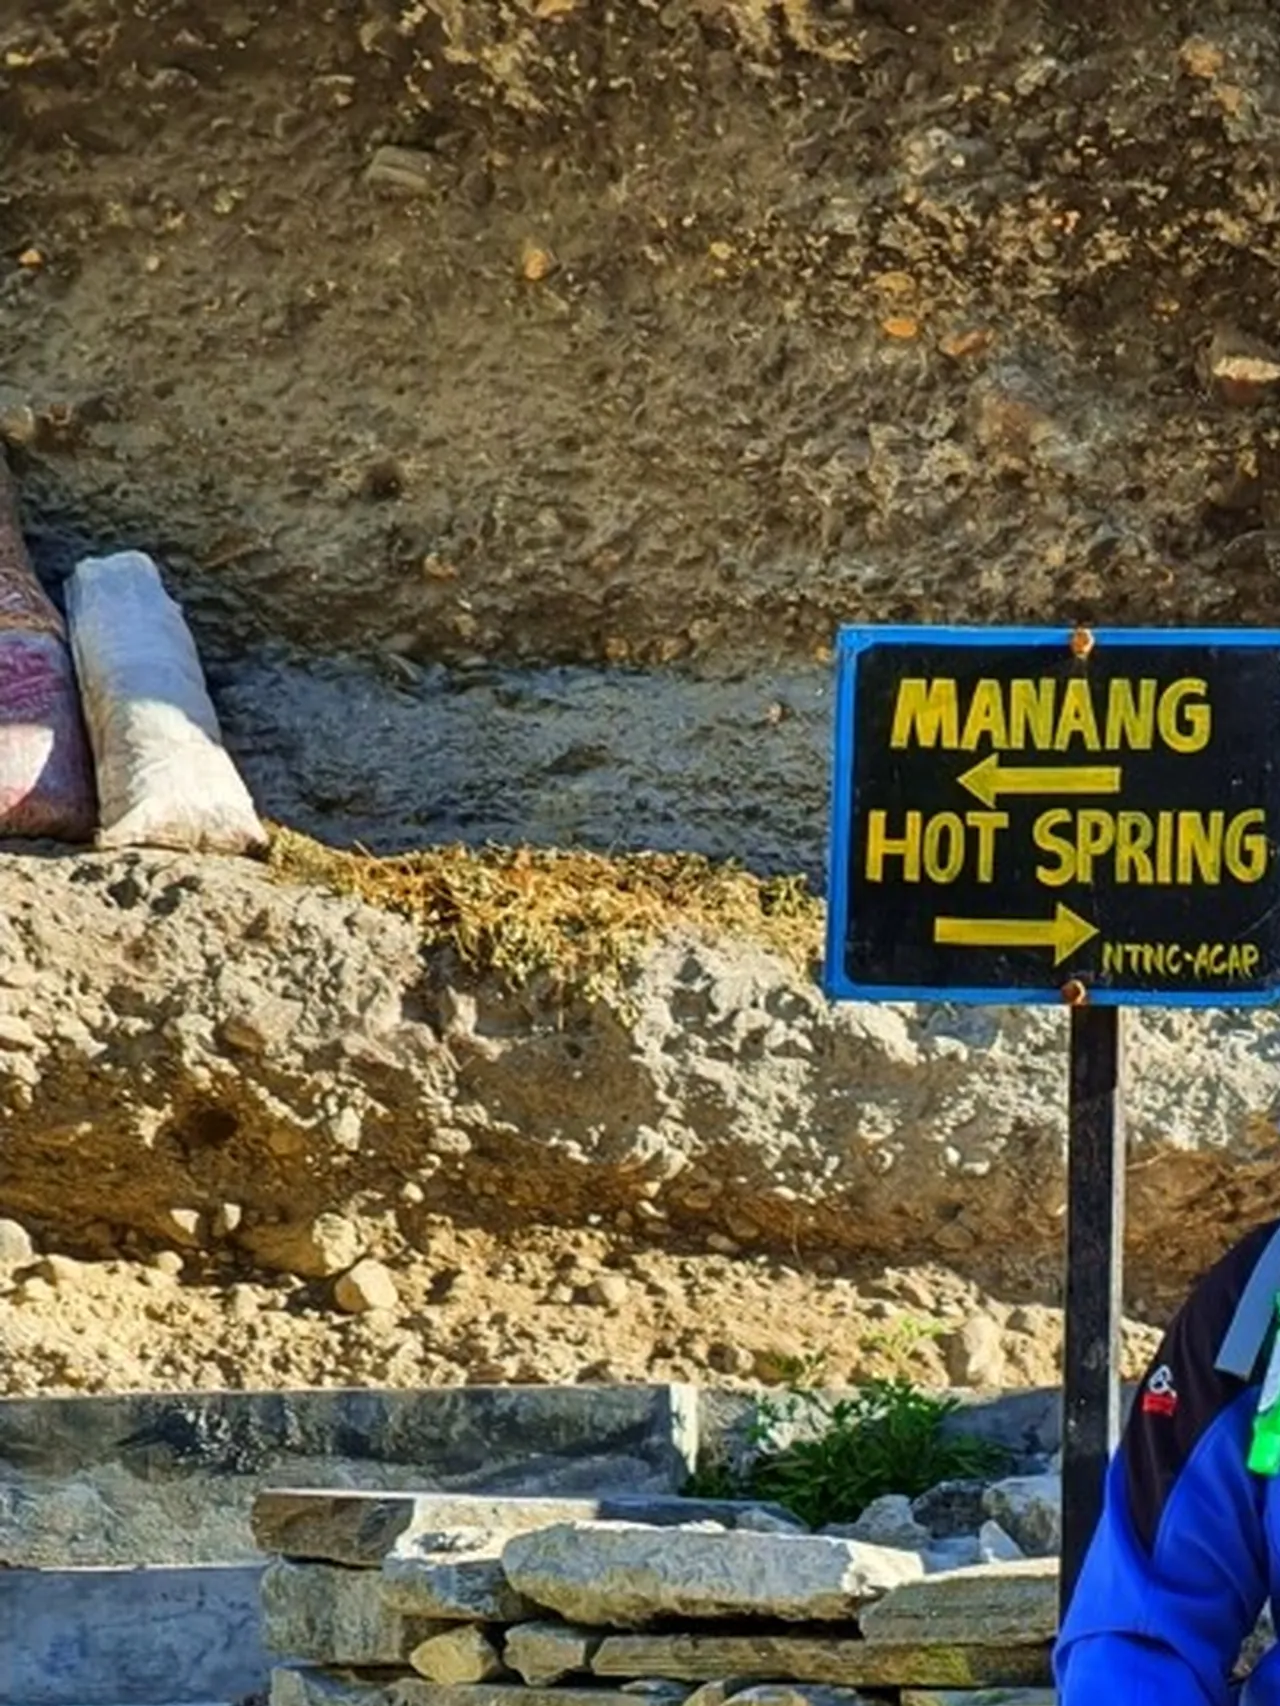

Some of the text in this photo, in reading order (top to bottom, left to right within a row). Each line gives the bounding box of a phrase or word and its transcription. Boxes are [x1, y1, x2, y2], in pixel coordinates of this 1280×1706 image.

[890, 677, 1212, 753] MANANG
[865, 808, 1268, 886] HOT SPRING
